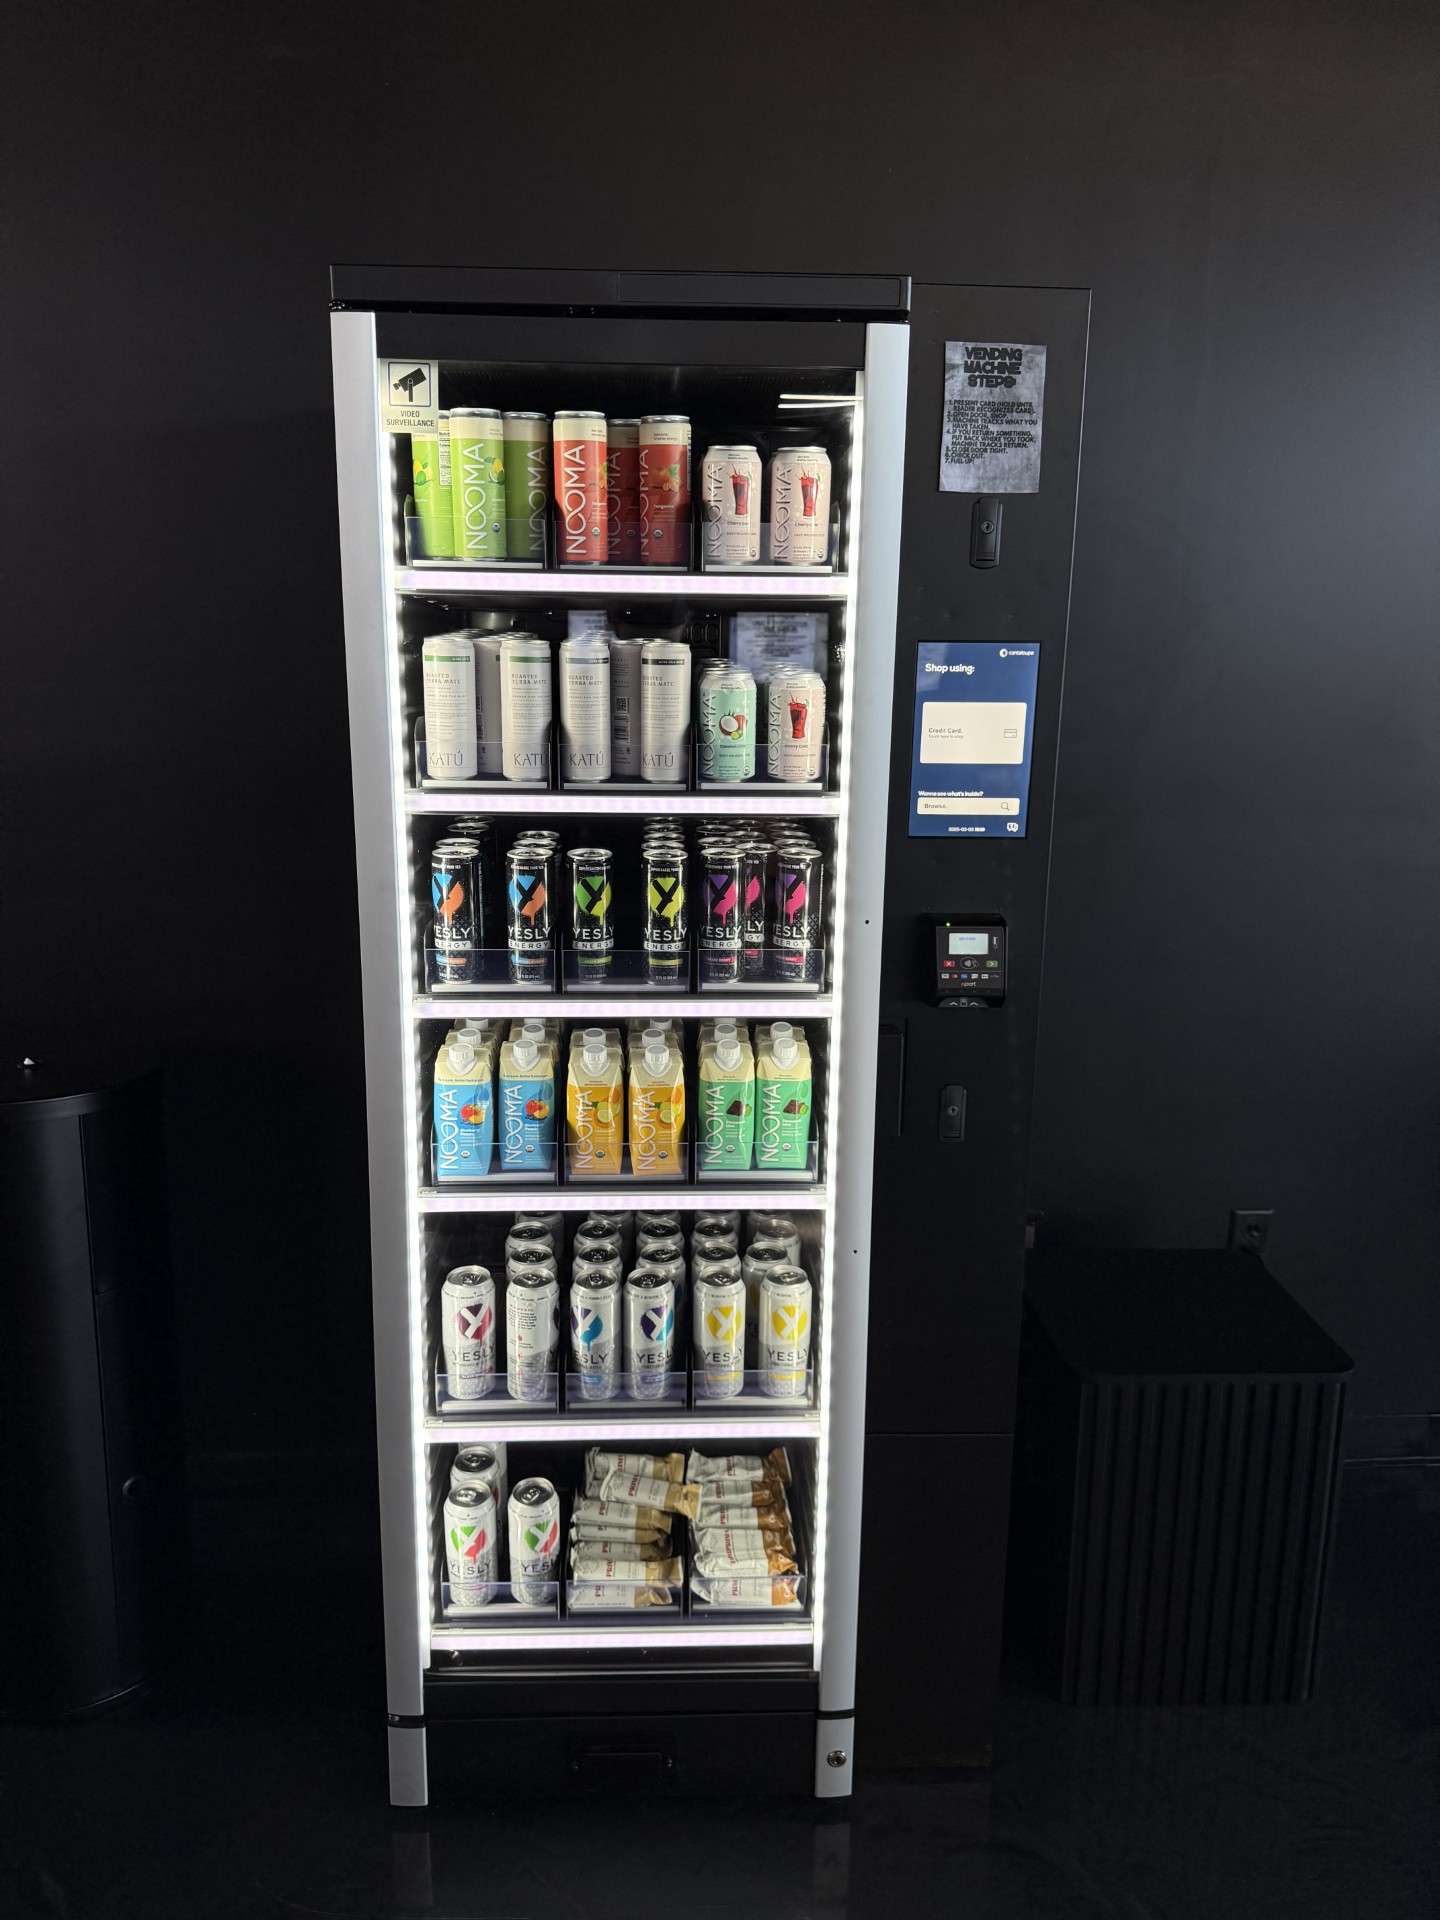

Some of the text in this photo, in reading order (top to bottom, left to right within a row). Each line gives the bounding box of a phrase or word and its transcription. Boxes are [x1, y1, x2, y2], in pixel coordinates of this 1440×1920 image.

[964, 346, 1023, 361] VENDING
[963, 360, 1022, 375] MACHINE
[386, 418, 434, 427] SURVEILLANCE
[463, 442, 488, 549] NOOMA
[563, 444, 587, 554] NOOMA
[925, 664, 975, 675] Shop using:
[430, 750, 463, 766] KATÚ
[514, 751, 549, 766] KATÚ
[570, 751, 604, 766] KATÚ
[642, 752, 674, 767] KATÚ
[434, 925, 470, 939] ESLY
[508, 925, 551, 939] YESLY
[572, 926, 614, 939] YESLY
[644, 927, 687, 941] YESLY
[773, 924, 810, 938] ESLY
[575, 940, 613, 949] ENERGY
[646, 942, 684, 950] ENERGY
[775, 938, 806, 947] NERGY
[439, 1089, 459, 1170] NOOMA
[504, 1084, 523, 1163] NOOMA
[575, 1090, 593, 1169] NOOMA
[637, 1091, 656, 1170] NOOMA
[704, 1085, 725, 1164] NOOMA
[760, 1084, 782, 1162] NOOMA
[452, 1344, 494, 1362] YESLY
[574, 1349, 608, 1364] ESLY
[636, 1346, 674, 1364] YESL
[702, 1348, 742, 1362] YESY
[450, 1560, 492, 1575] YESLY
[522, 1560, 554, 1573] YES
